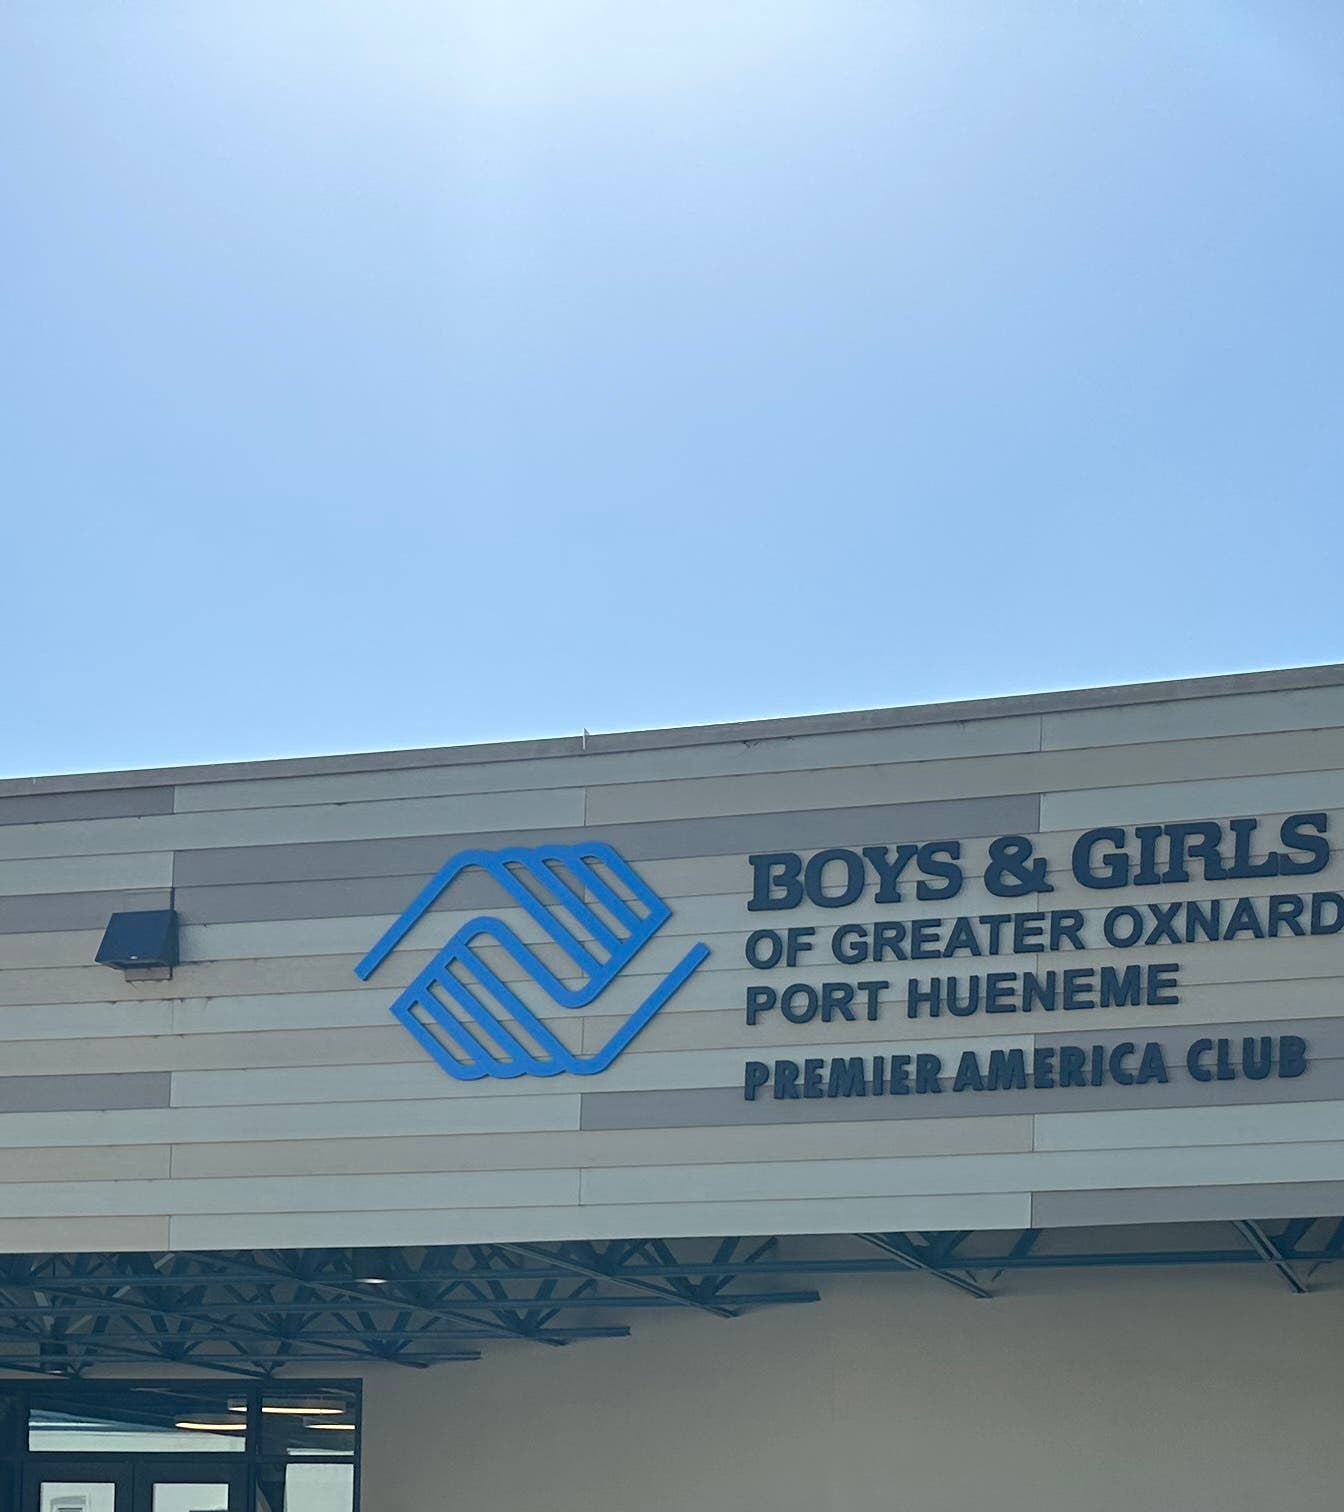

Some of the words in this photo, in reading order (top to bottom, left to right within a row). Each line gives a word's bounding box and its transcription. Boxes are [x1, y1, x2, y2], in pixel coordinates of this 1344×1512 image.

[747, 841, 963, 911] BOYS
[984, 835, 1054, 898] &
[1072, 812, 1330, 889] GIRLS
[745, 926, 816, 969] OF
[832, 910, 1086, 964] GREATER
[746, 980, 889, 1026] PORT
[907, 963, 1180, 1018] HUENEME
[744, 1053, 942, 1101] PREMIER
[953, 1042, 1169, 1092] AMERICA
[1186, 1035, 1309, 1082] CLUB
